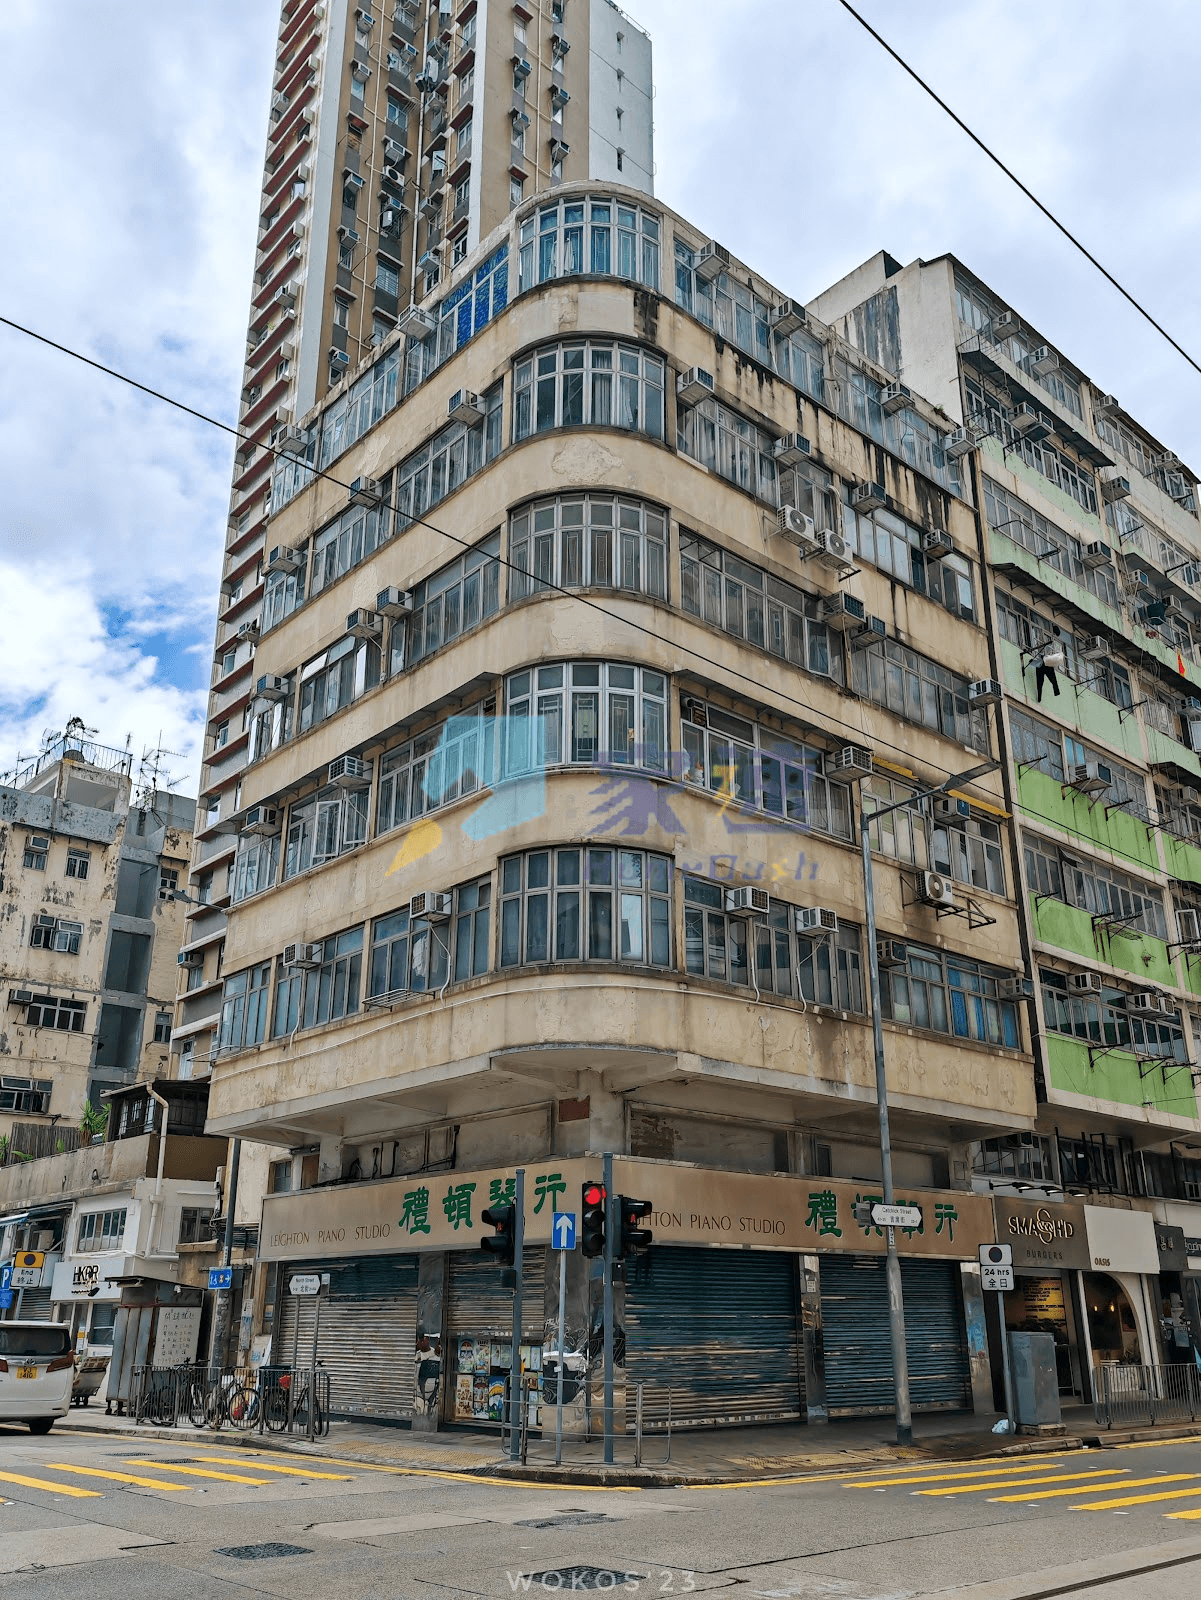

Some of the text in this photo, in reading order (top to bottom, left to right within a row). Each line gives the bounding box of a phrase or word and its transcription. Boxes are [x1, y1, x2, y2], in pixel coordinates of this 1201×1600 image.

[804, 1189, 958, 1243] 禮行
[690, 1213, 732, 1231] PIANO
[739, 1216, 786, 1236] STUDIO
[270, 1223, 391, 1248] LEIGHTON PIANO STUDIO
[1026, 1249, 1063, 1260] BURGERS
[1094, 1257, 1111, 1267] OASIS
[1, 1268, 10, 1288] P
[984, 1268, 1010, 1276] 24 hrs
[988, 1278, 1007, 1288] 全日
